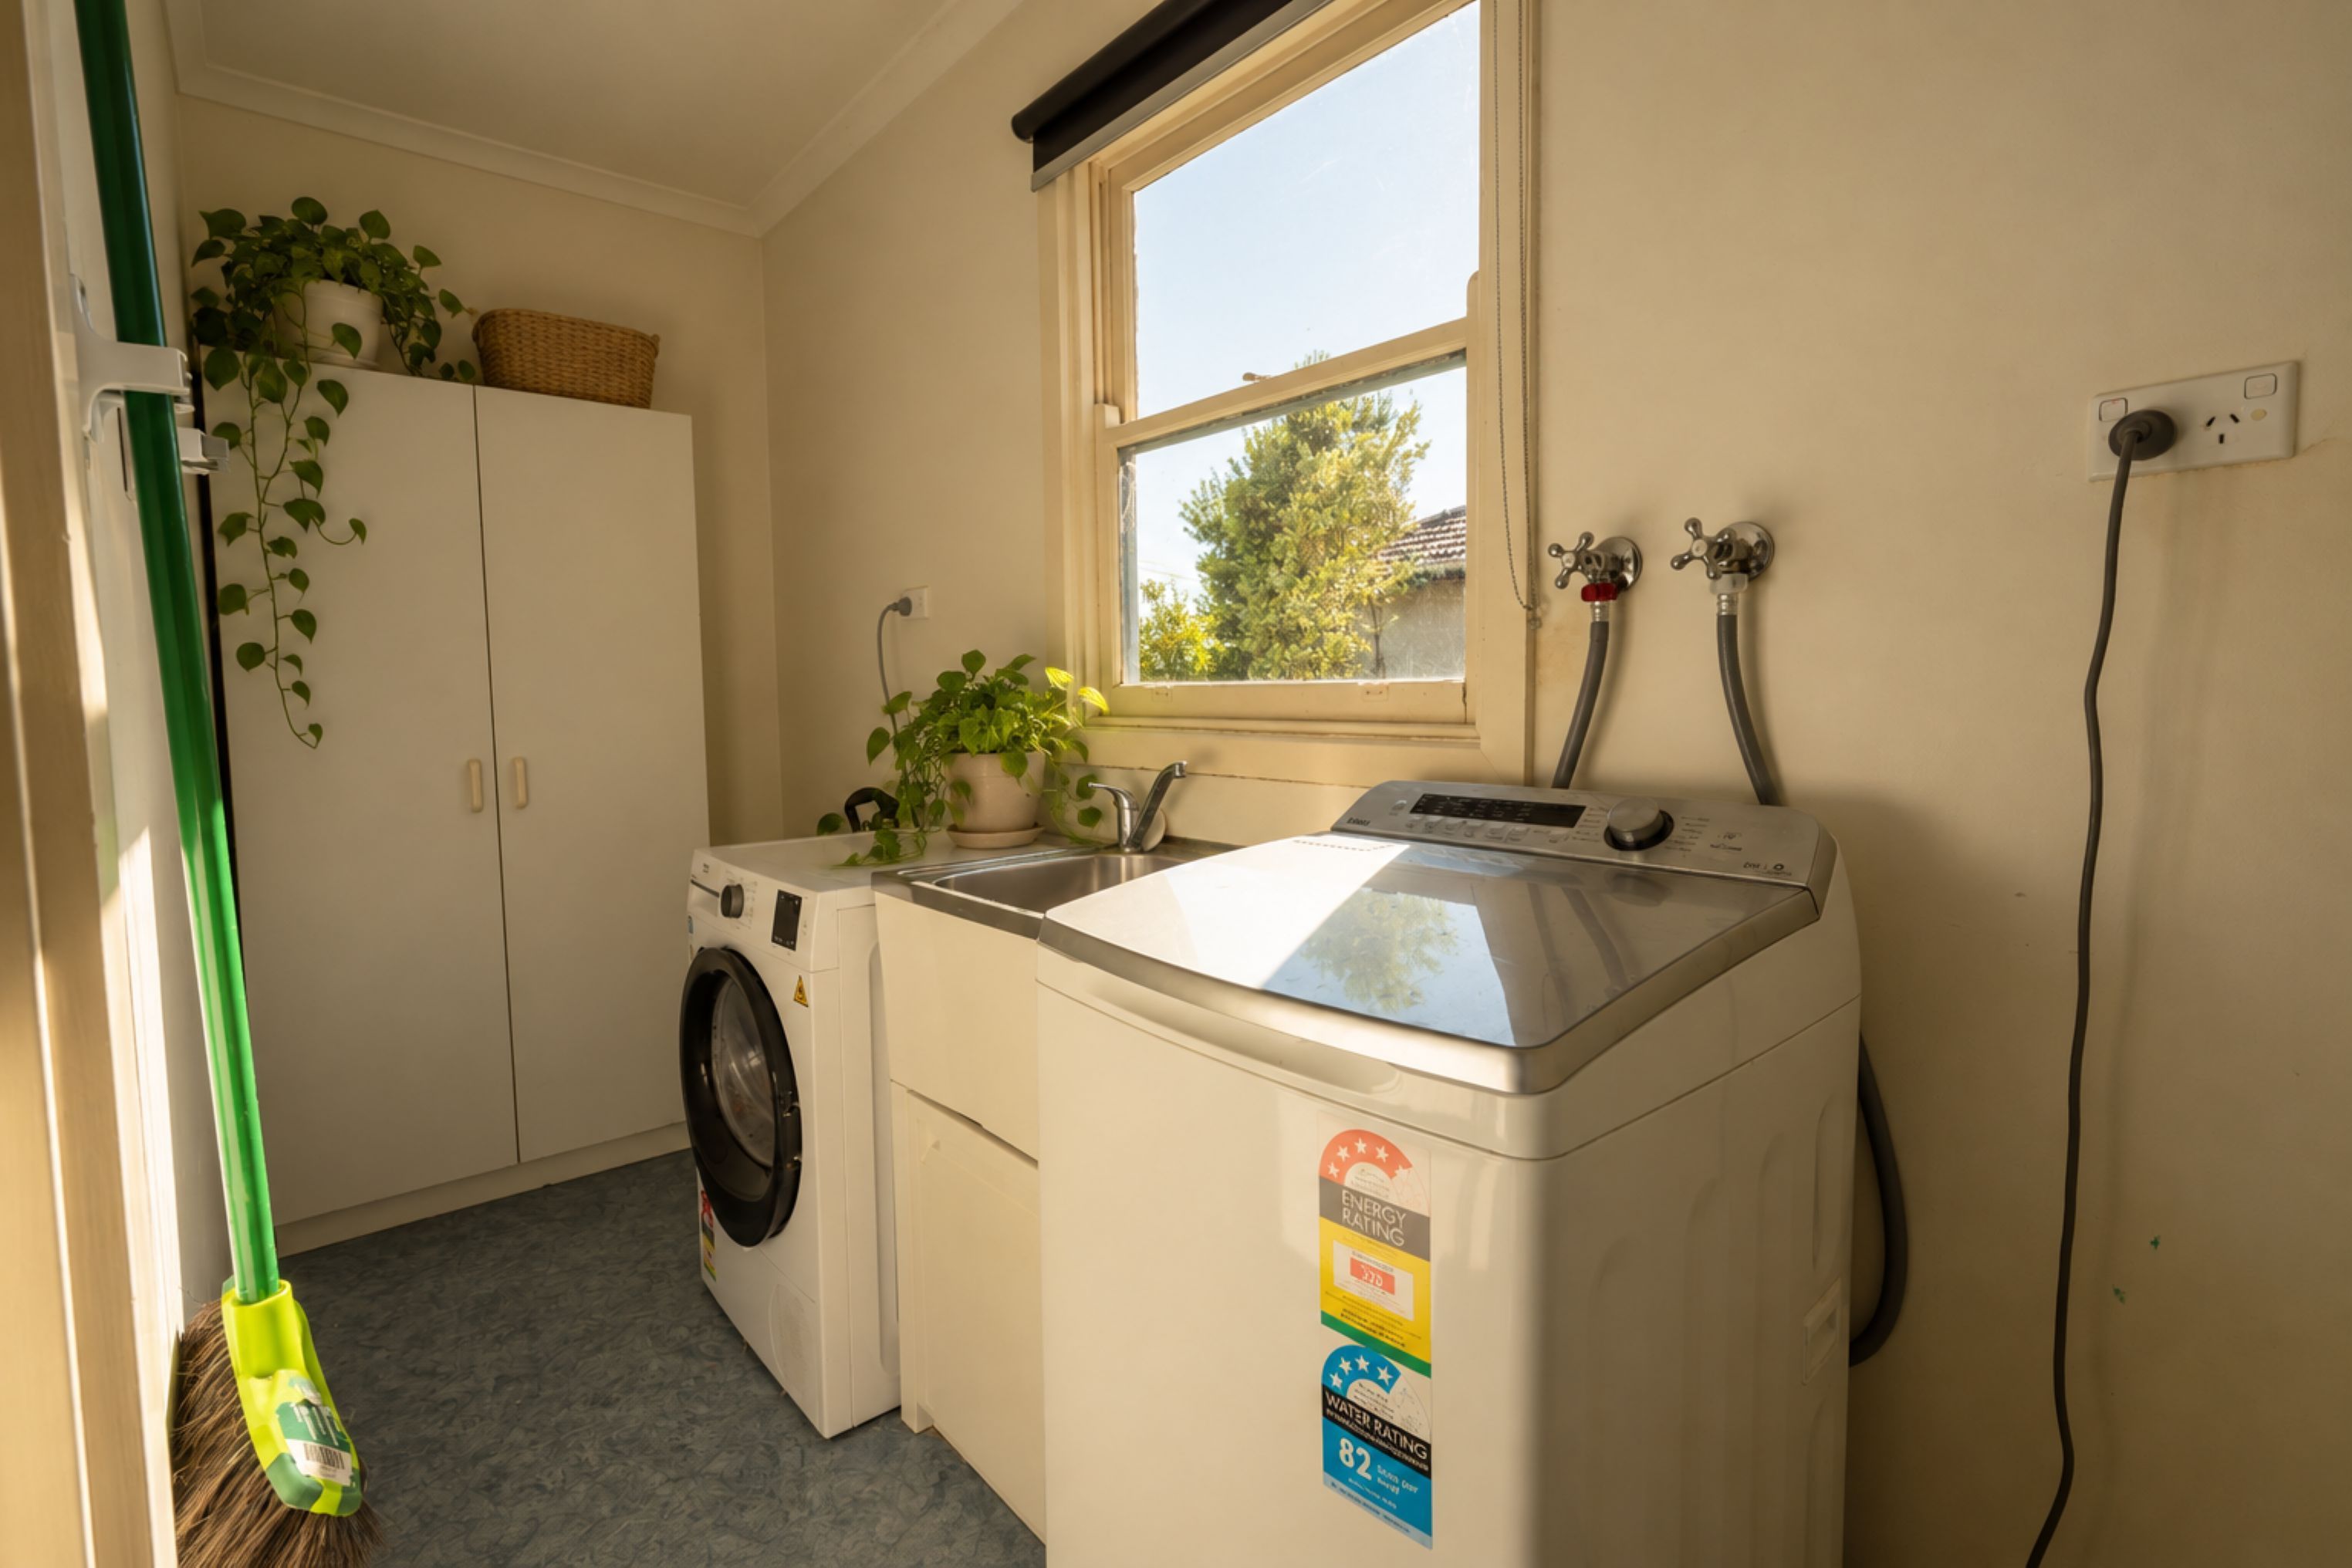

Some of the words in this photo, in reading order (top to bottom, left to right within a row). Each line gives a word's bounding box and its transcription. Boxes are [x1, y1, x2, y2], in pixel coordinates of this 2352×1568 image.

[1342, 1189, 1406, 1228] ENERGY
[1342, 1207, 1404, 1247] RATING
[1325, 1391, 1371, 1428] WATER
[1374, 1418, 1428, 1460] RATING
[1339, 1437, 1372, 1480] 82
